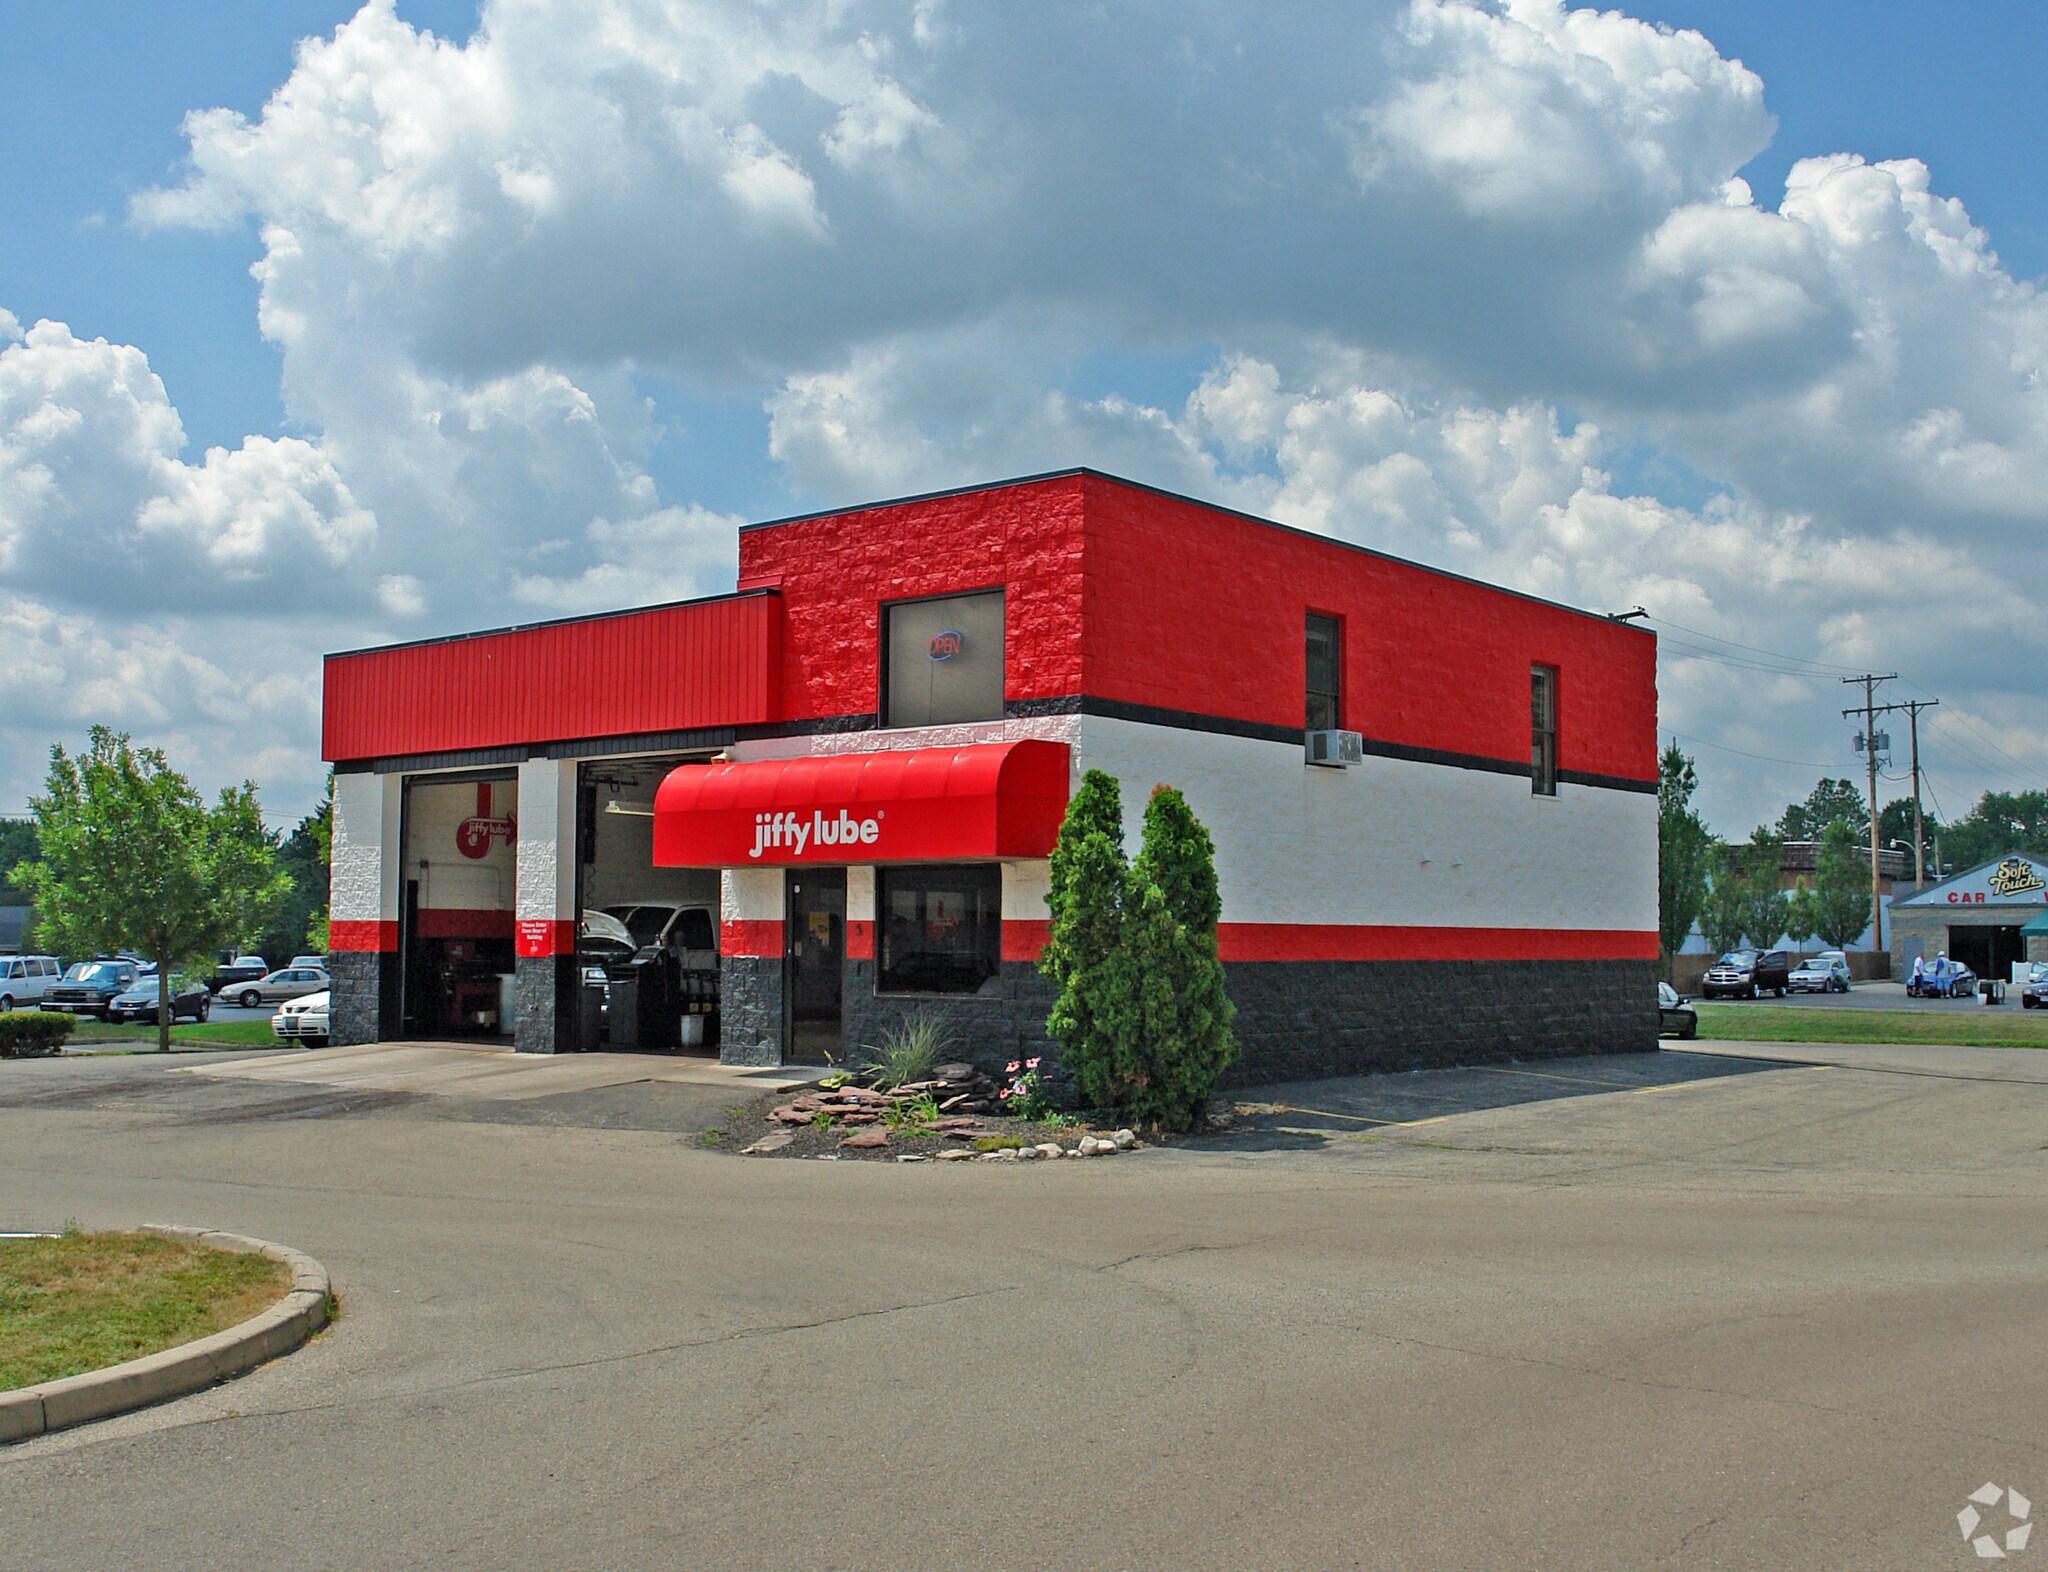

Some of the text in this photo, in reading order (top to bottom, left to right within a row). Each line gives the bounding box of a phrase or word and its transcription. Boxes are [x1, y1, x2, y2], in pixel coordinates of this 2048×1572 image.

[927, 637, 961, 654] OPEN
[467, 821, 511, 836] jiffy lube
[749, 809, 879, 858] jiffy lube
[1998, 860, 2030, 880] Soft
[1989, 873, 2045, 897] Touch
[1947, 892, 1985, 903] CAR
